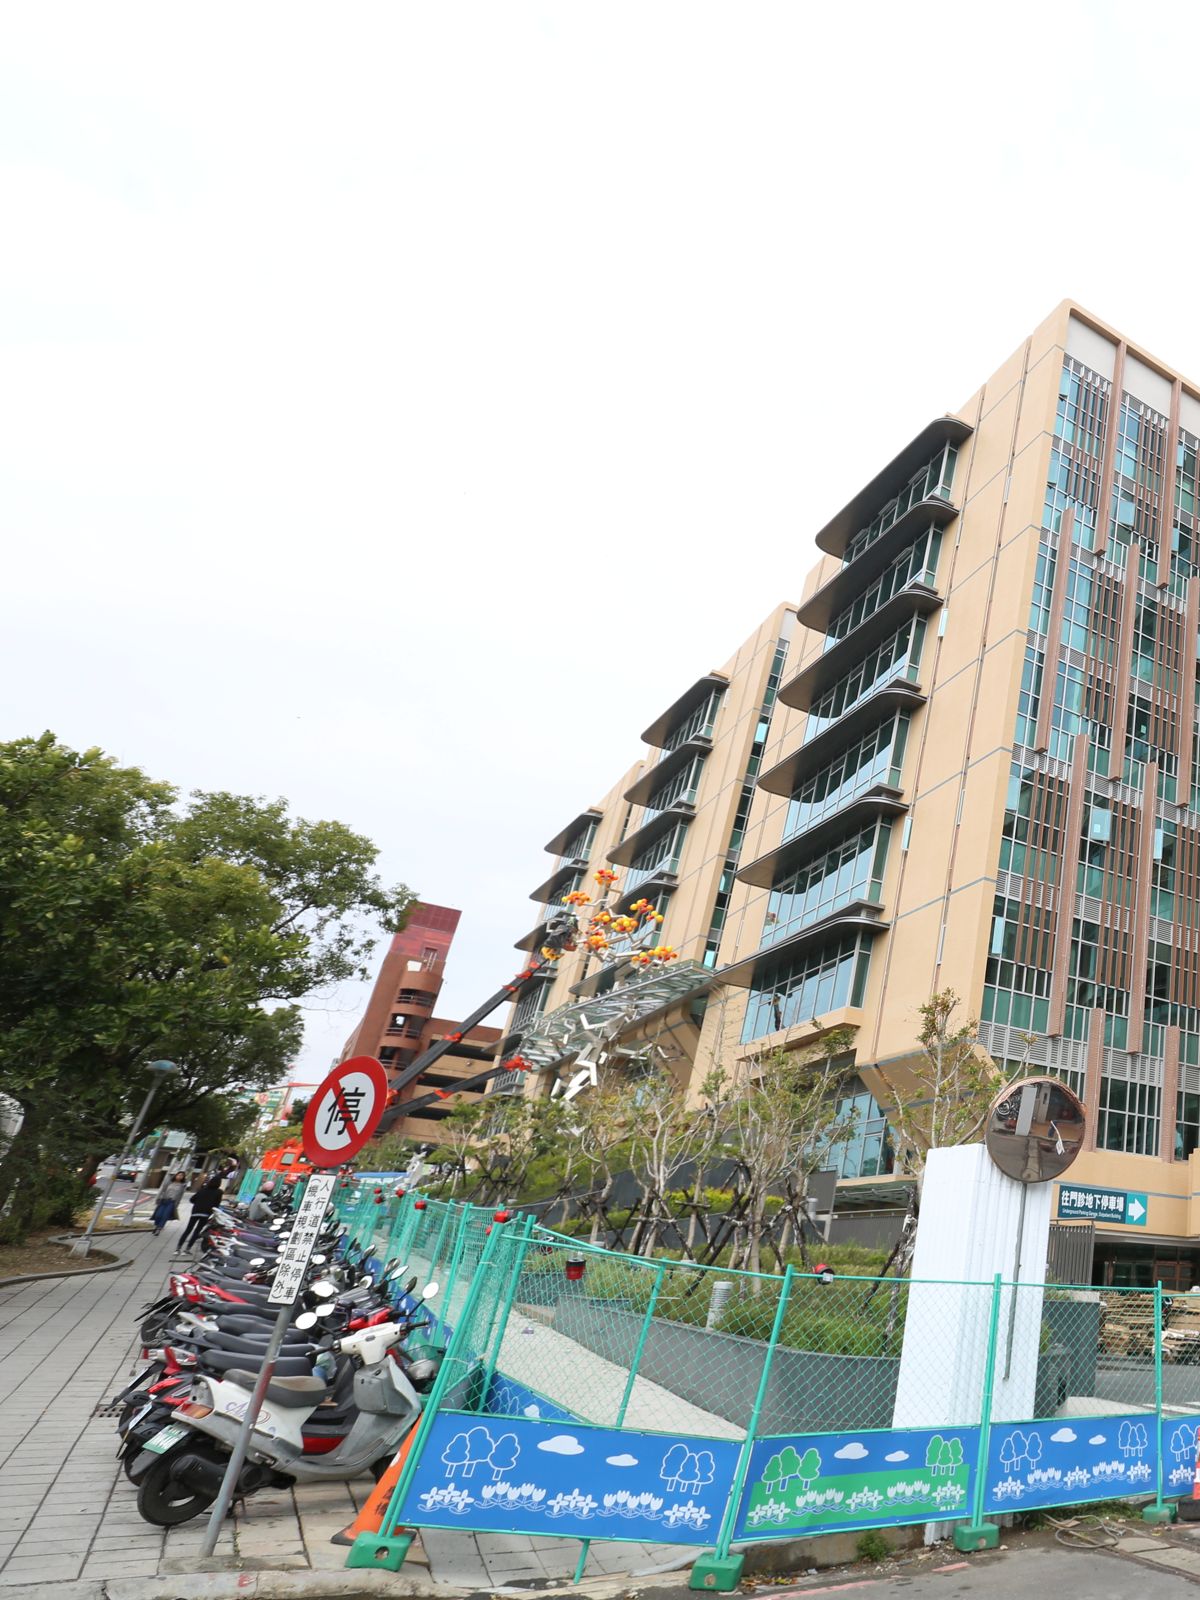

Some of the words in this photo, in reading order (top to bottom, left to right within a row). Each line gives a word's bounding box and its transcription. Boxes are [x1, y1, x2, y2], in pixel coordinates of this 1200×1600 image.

[324, 1087, 366, 1135] 停
[1061, 1190, 1124, 1212] 往門診地下停車場
[283, 1180, 330, 1298] 人行道禁止停車
